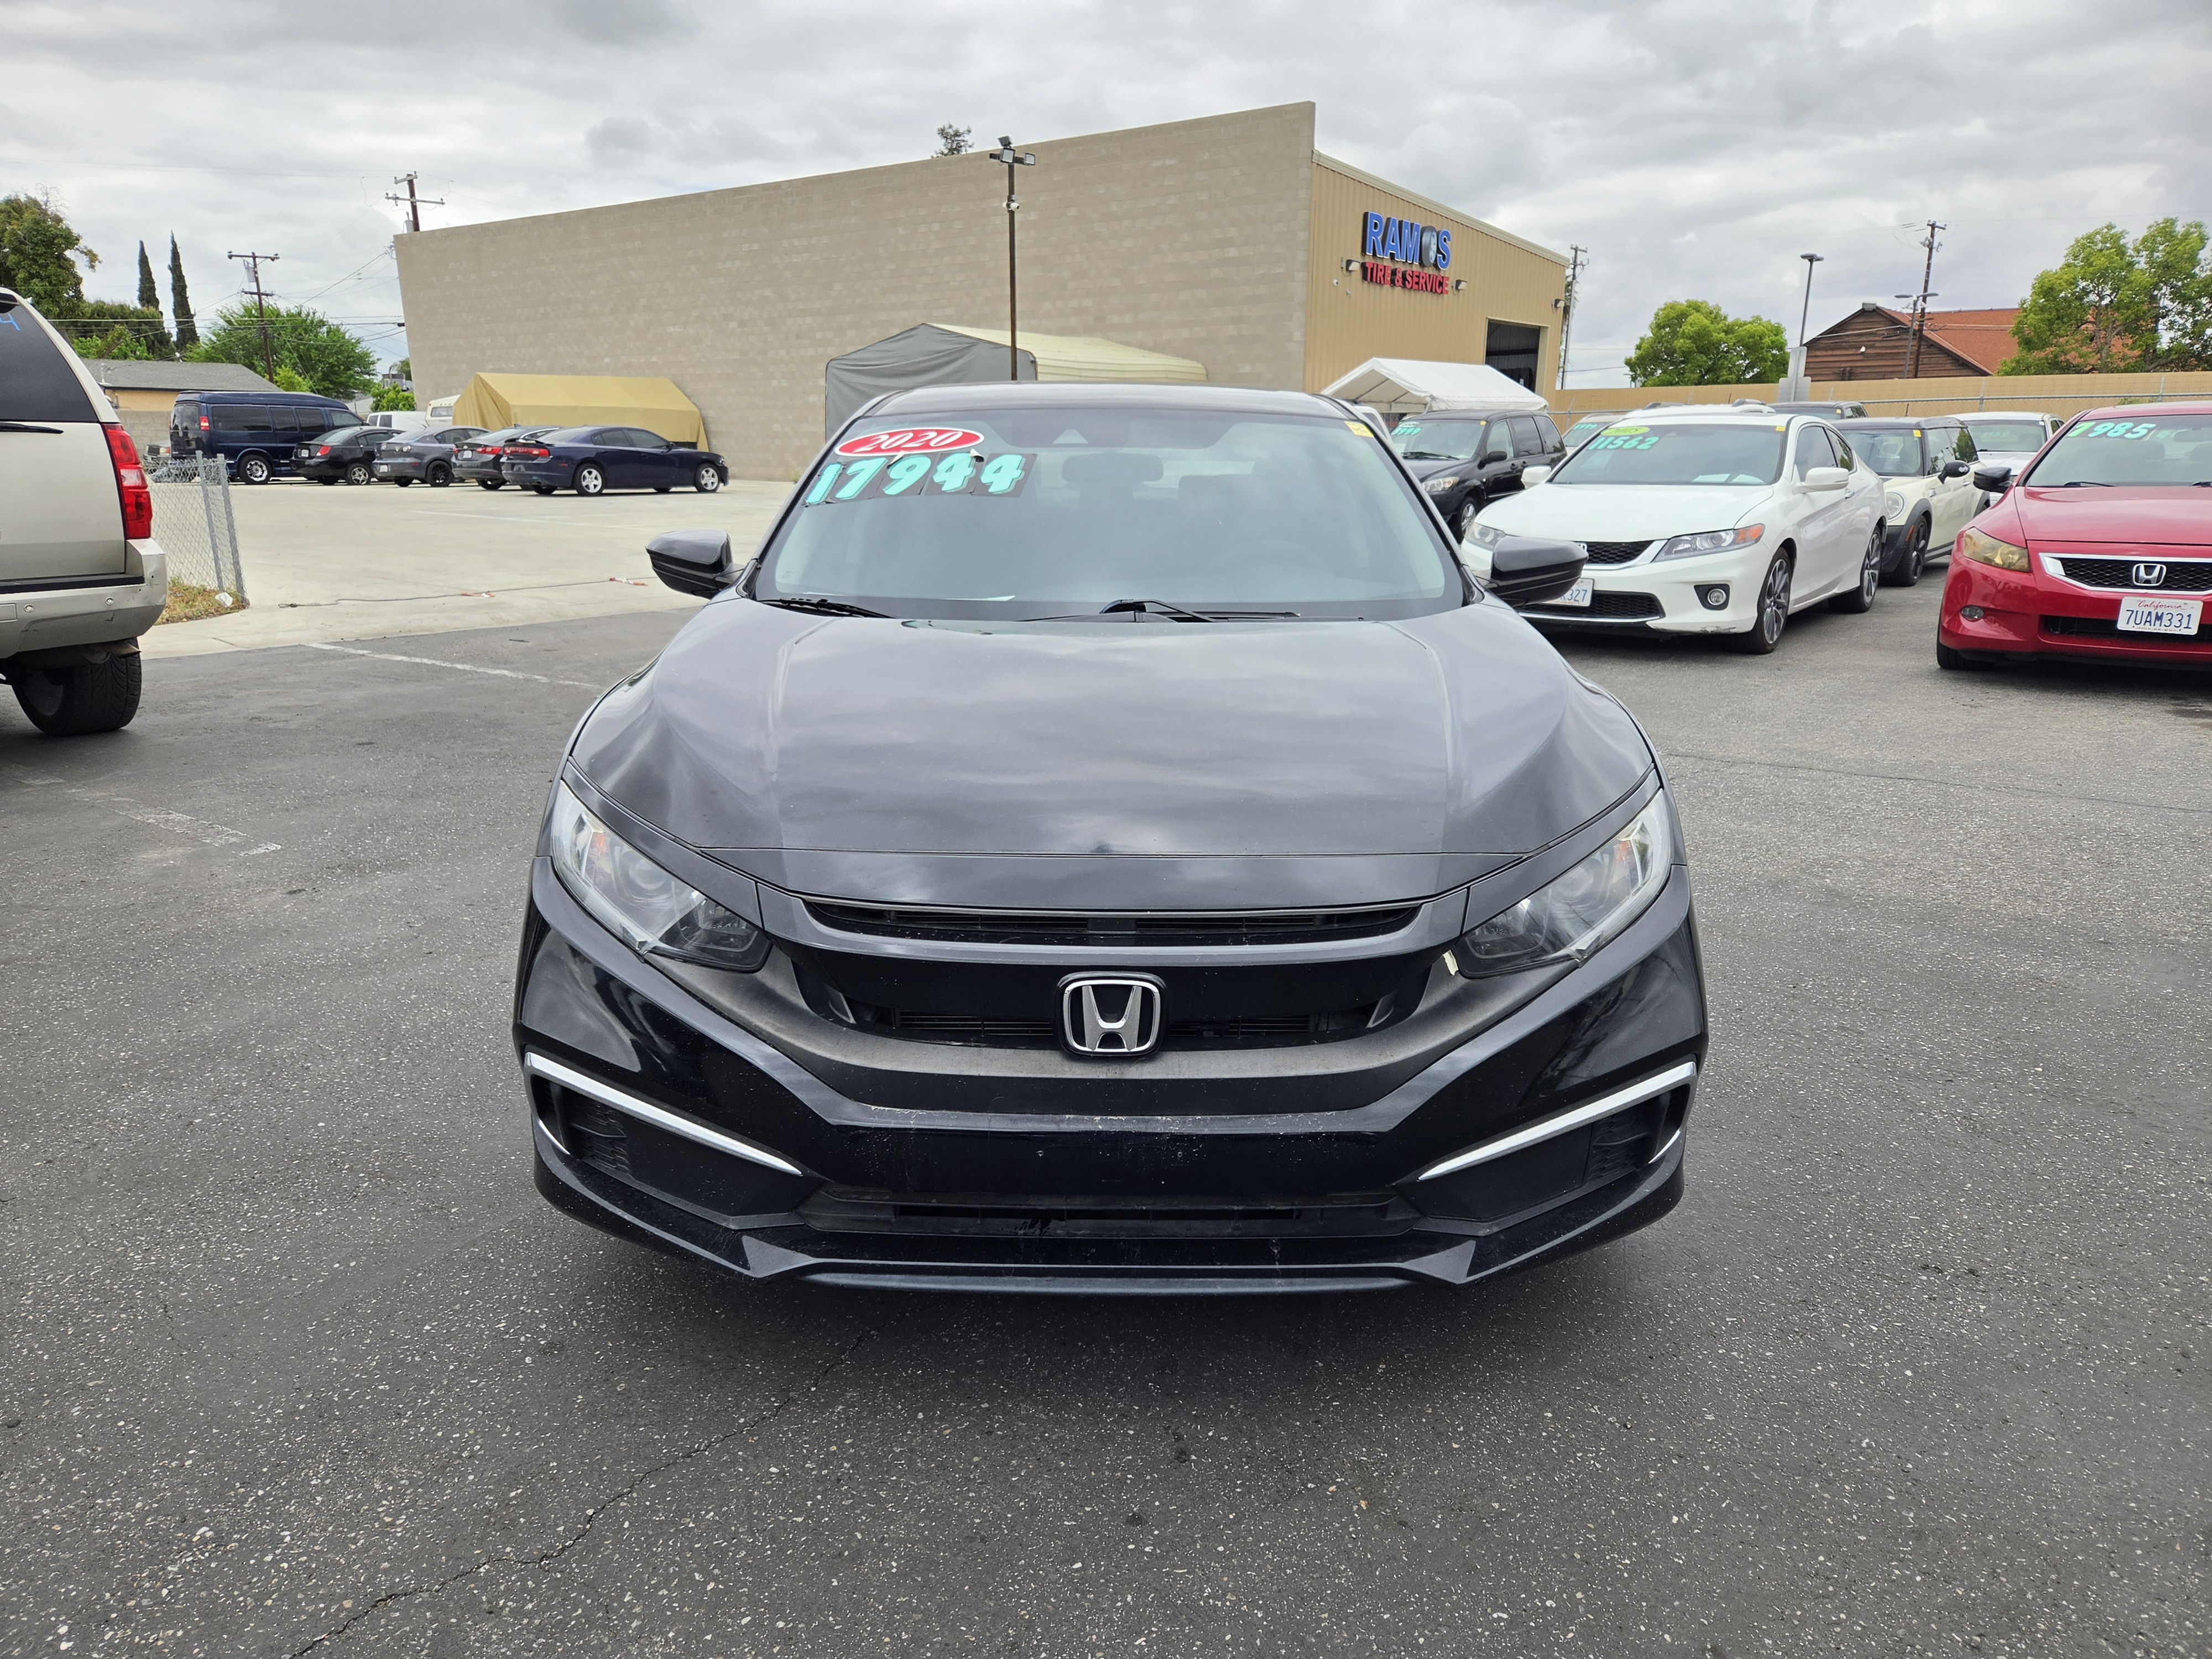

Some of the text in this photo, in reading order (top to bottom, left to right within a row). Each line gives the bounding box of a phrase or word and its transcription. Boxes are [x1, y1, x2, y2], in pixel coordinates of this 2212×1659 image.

[1362, 212, 1451, 270] RAMOS
[1363, 261, 1449, 295] TIRE & SERVICE
[853, 431, 964, 453] 2020
[1588, 436, 1660, 450] 11562
[805, 453, 1025, 504] 17944
[2137, 599, 2187, 611] California
[2126, 609, 2192, 629] 7UAM331
